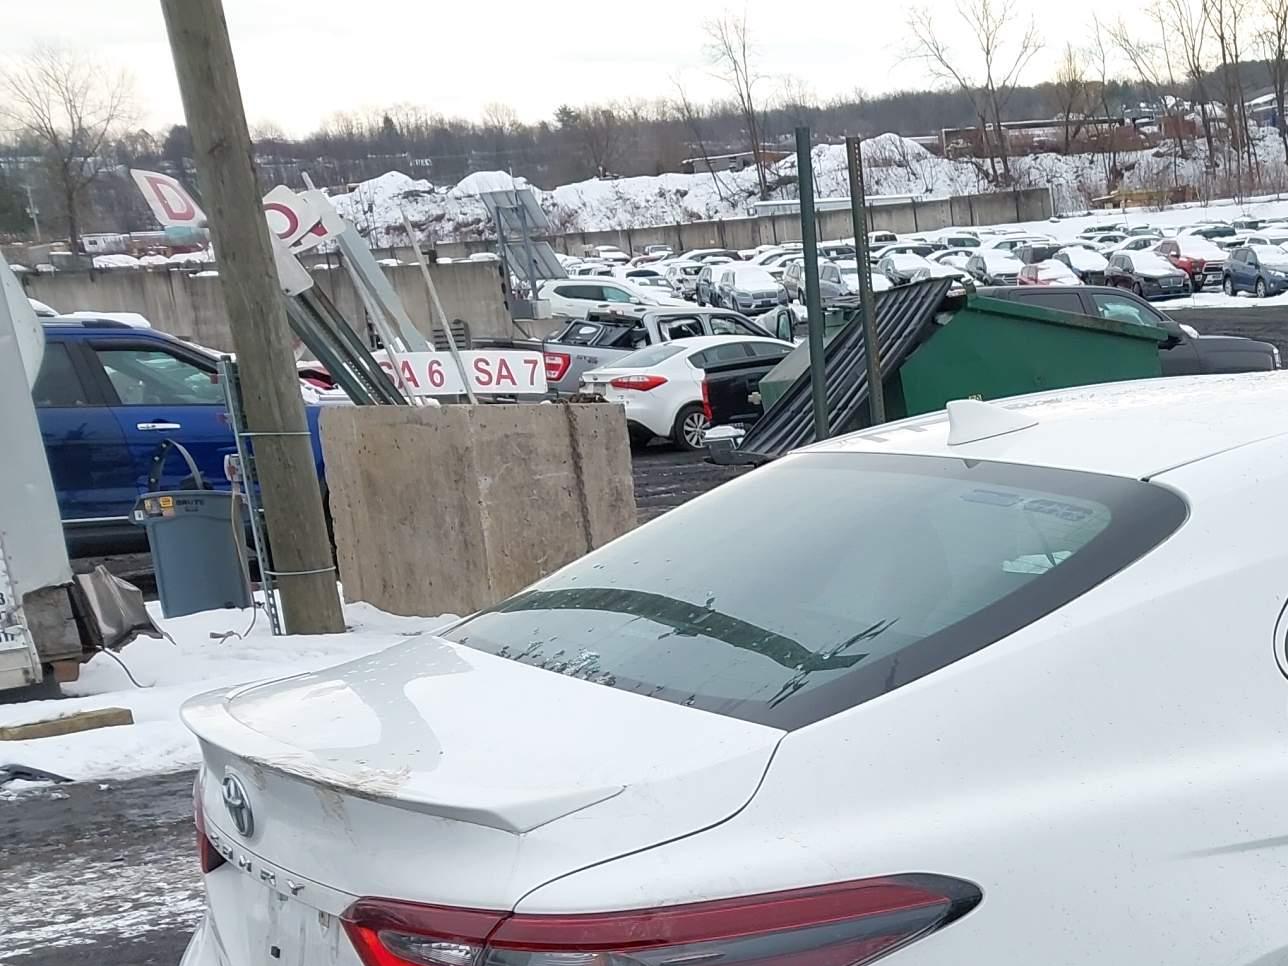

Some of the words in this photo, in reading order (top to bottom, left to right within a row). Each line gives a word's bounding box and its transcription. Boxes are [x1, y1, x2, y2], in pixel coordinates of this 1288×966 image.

[144, 175, 196, 221] D
[377, 358, 420, 389] SA
[427, 359, 445, 388] 6
[473, 357, 517, 387] SA
[522, 358, 539, 387] 7
